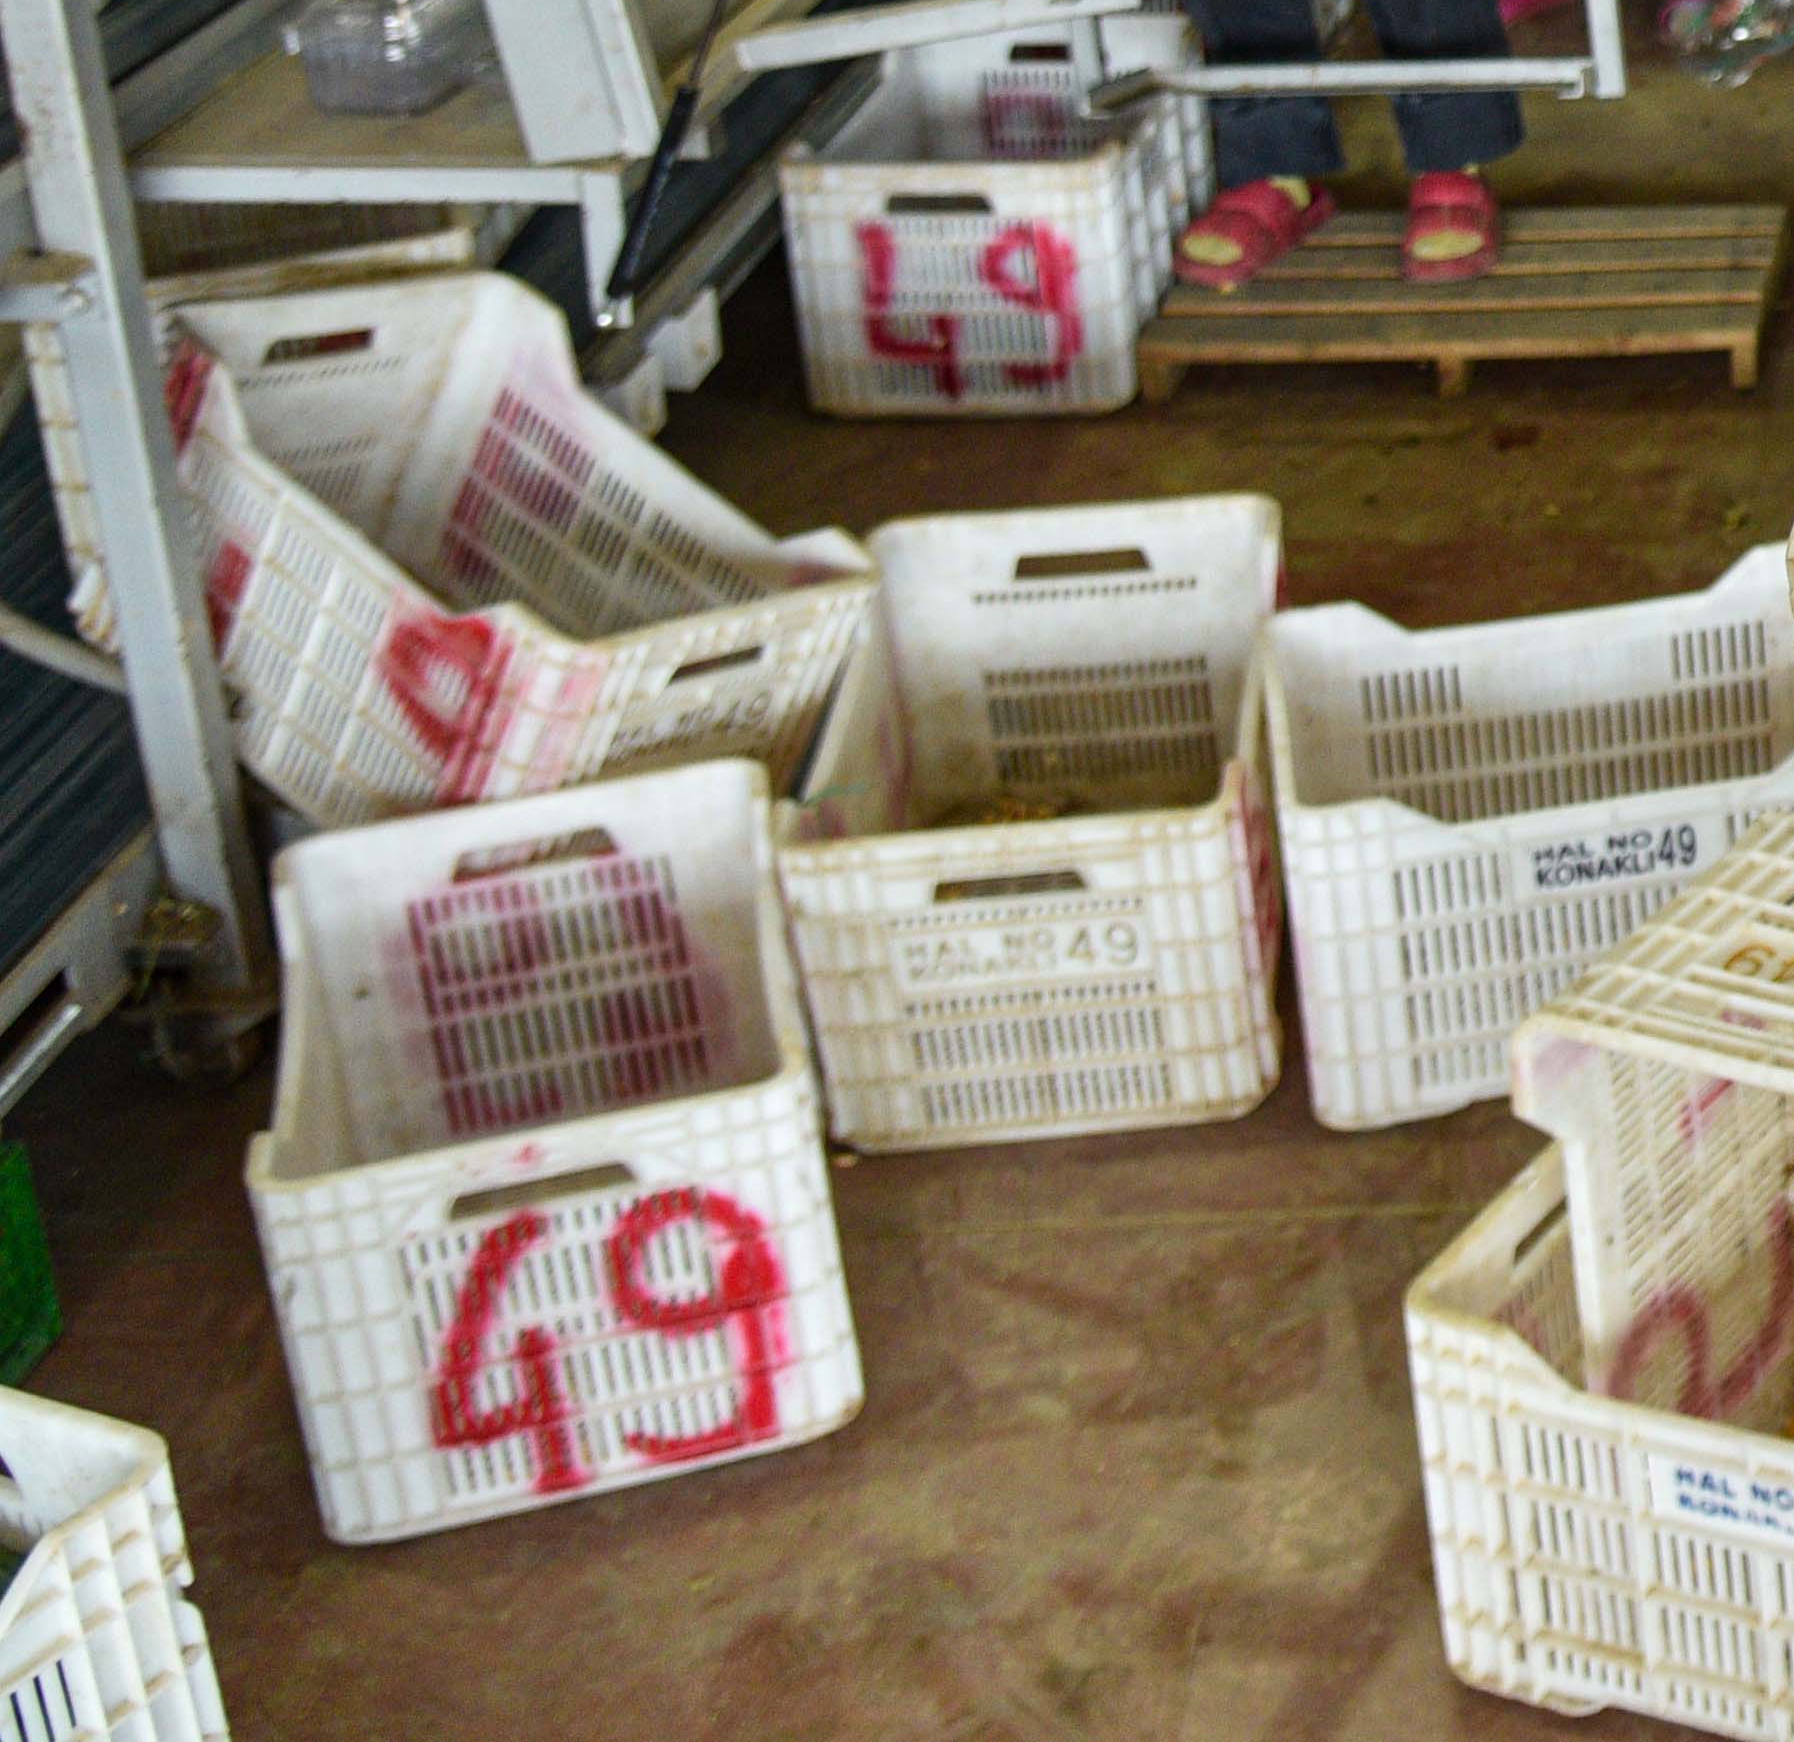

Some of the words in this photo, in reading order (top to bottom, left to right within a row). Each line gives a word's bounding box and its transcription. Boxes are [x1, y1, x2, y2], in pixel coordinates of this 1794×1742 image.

[1534, 841, 1594, 862] HAL
[1607, 828, 1653, 850] NO
[1658, 822, 1698, 869] 49
[1536, 850, 1656, 888] KONAKLI
[1068, 920, 1139, 967] 49
[431, 1185, 790, 1495] 49
[1676, 1465, 1736, 1499] HAL
[1751, 1482, 1794, 1512] NO
